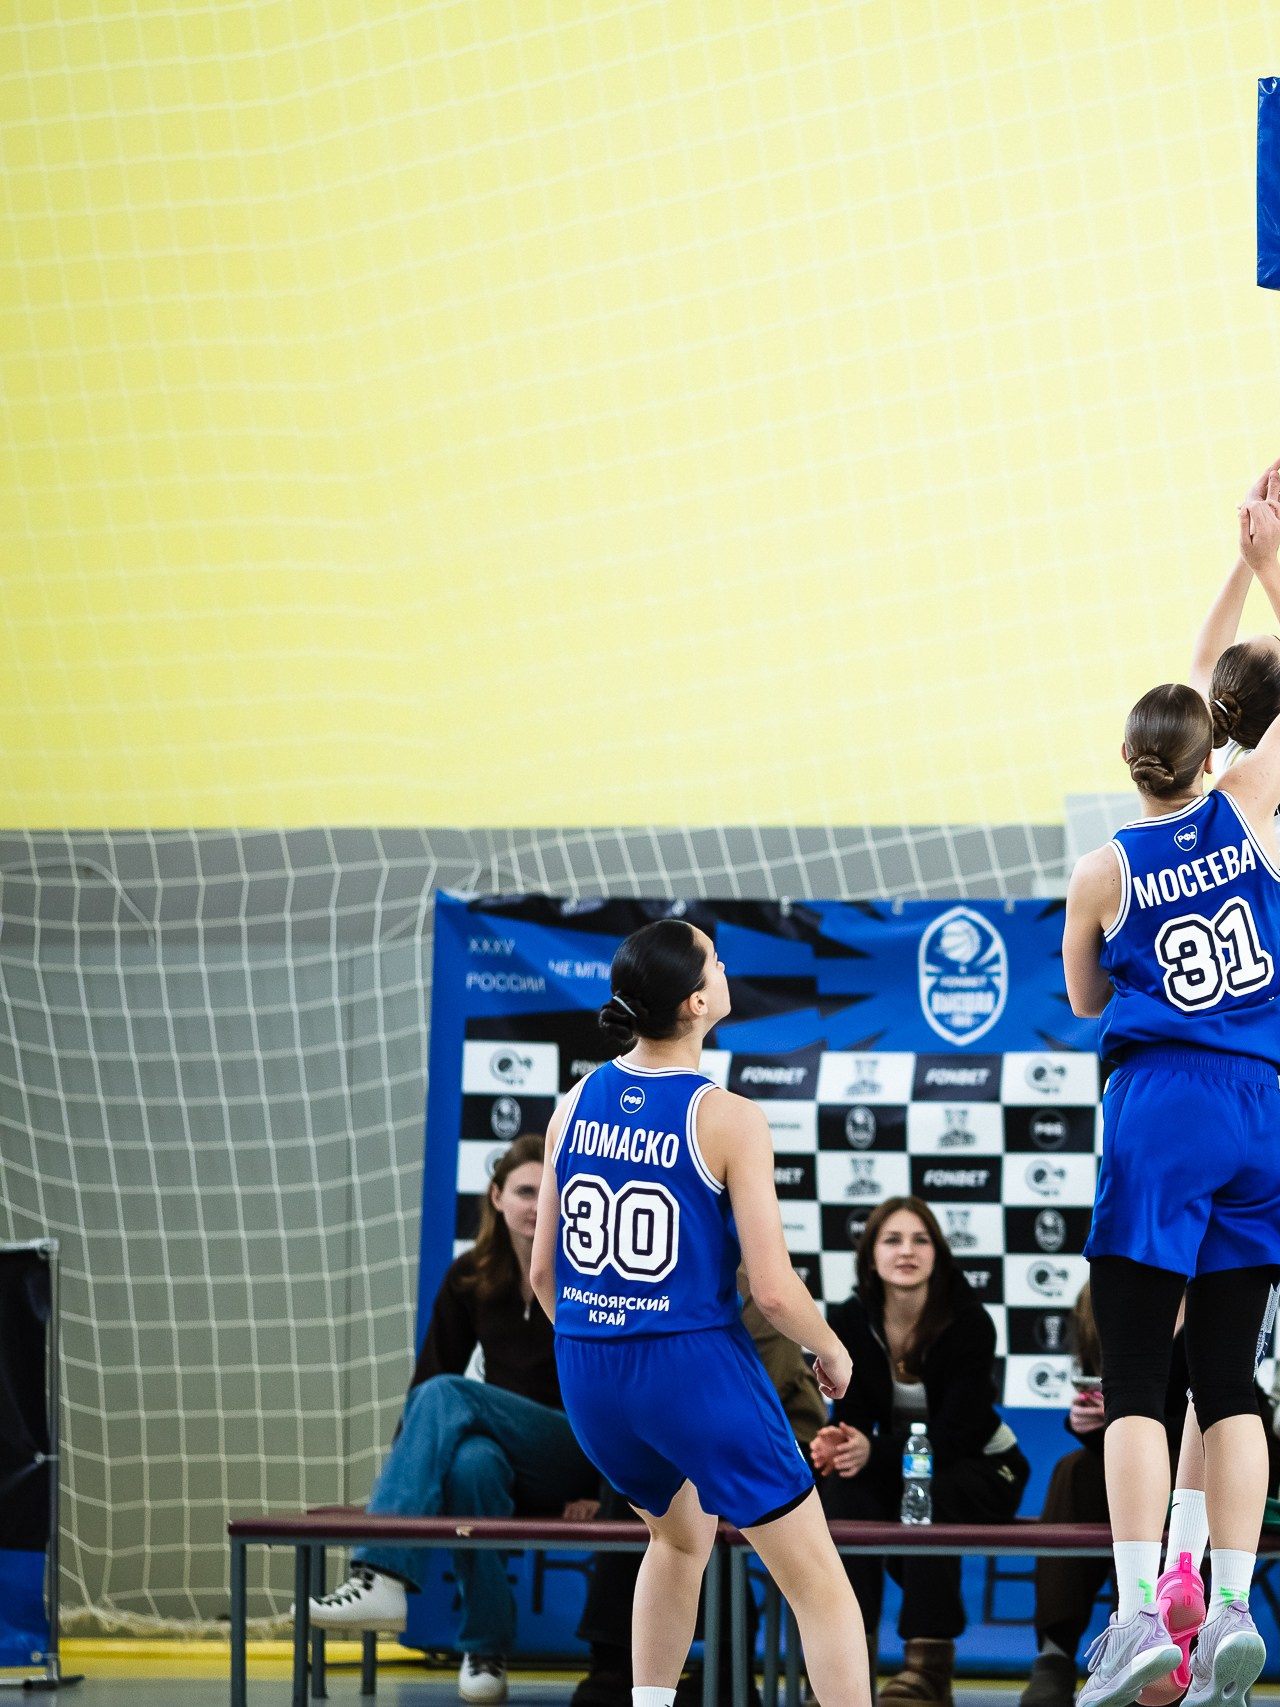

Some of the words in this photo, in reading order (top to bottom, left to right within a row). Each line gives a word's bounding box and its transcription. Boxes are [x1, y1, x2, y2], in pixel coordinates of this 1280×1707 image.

[1177, 831, 1196, 844] РФБ
[1133, 838, 1257, 910] МОСЕЕВА
[1154, 895, 1275, 1012] 31
[465, 971, 546, 993] РОССИИ
[740, 1066, 808, 1085] FONBET
[925, 1068, 991, 1086] FONBET
[624, 1094, 643, 1105] РФБ
[569, 1119, 680, 1169] ЛОМАСКО
[923, 1169, 990, 1187] FONBET
[561, 1173, 680, 1283] 30
[563, 1285, 671, 1312] КРАСНОЯРСКИЙ
[588, 1309, 627, 1327] КРАЙ
